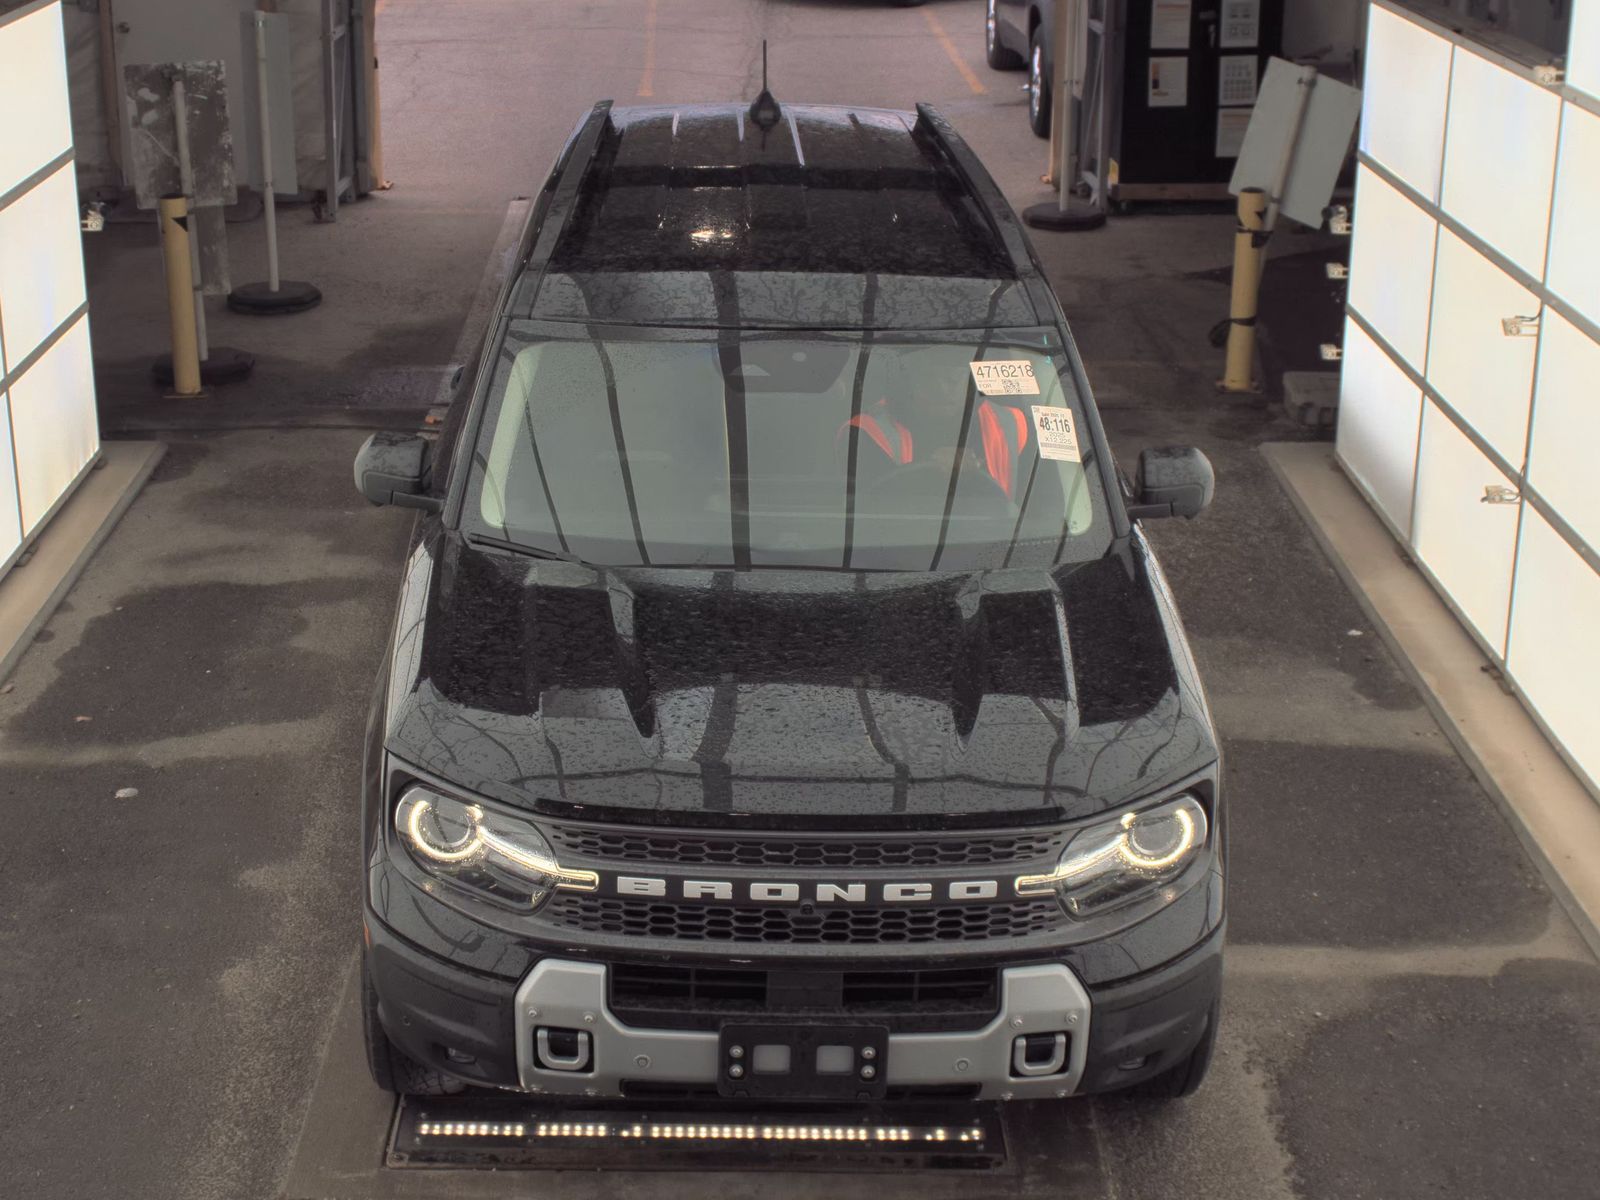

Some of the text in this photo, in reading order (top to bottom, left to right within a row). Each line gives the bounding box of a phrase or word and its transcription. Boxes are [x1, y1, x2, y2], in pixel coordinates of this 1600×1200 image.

[976, 365, 1034, 378] 4716218
[1040, 417, 1070, 433] 48:116
[617, 876, 998, 902] BRONCO
